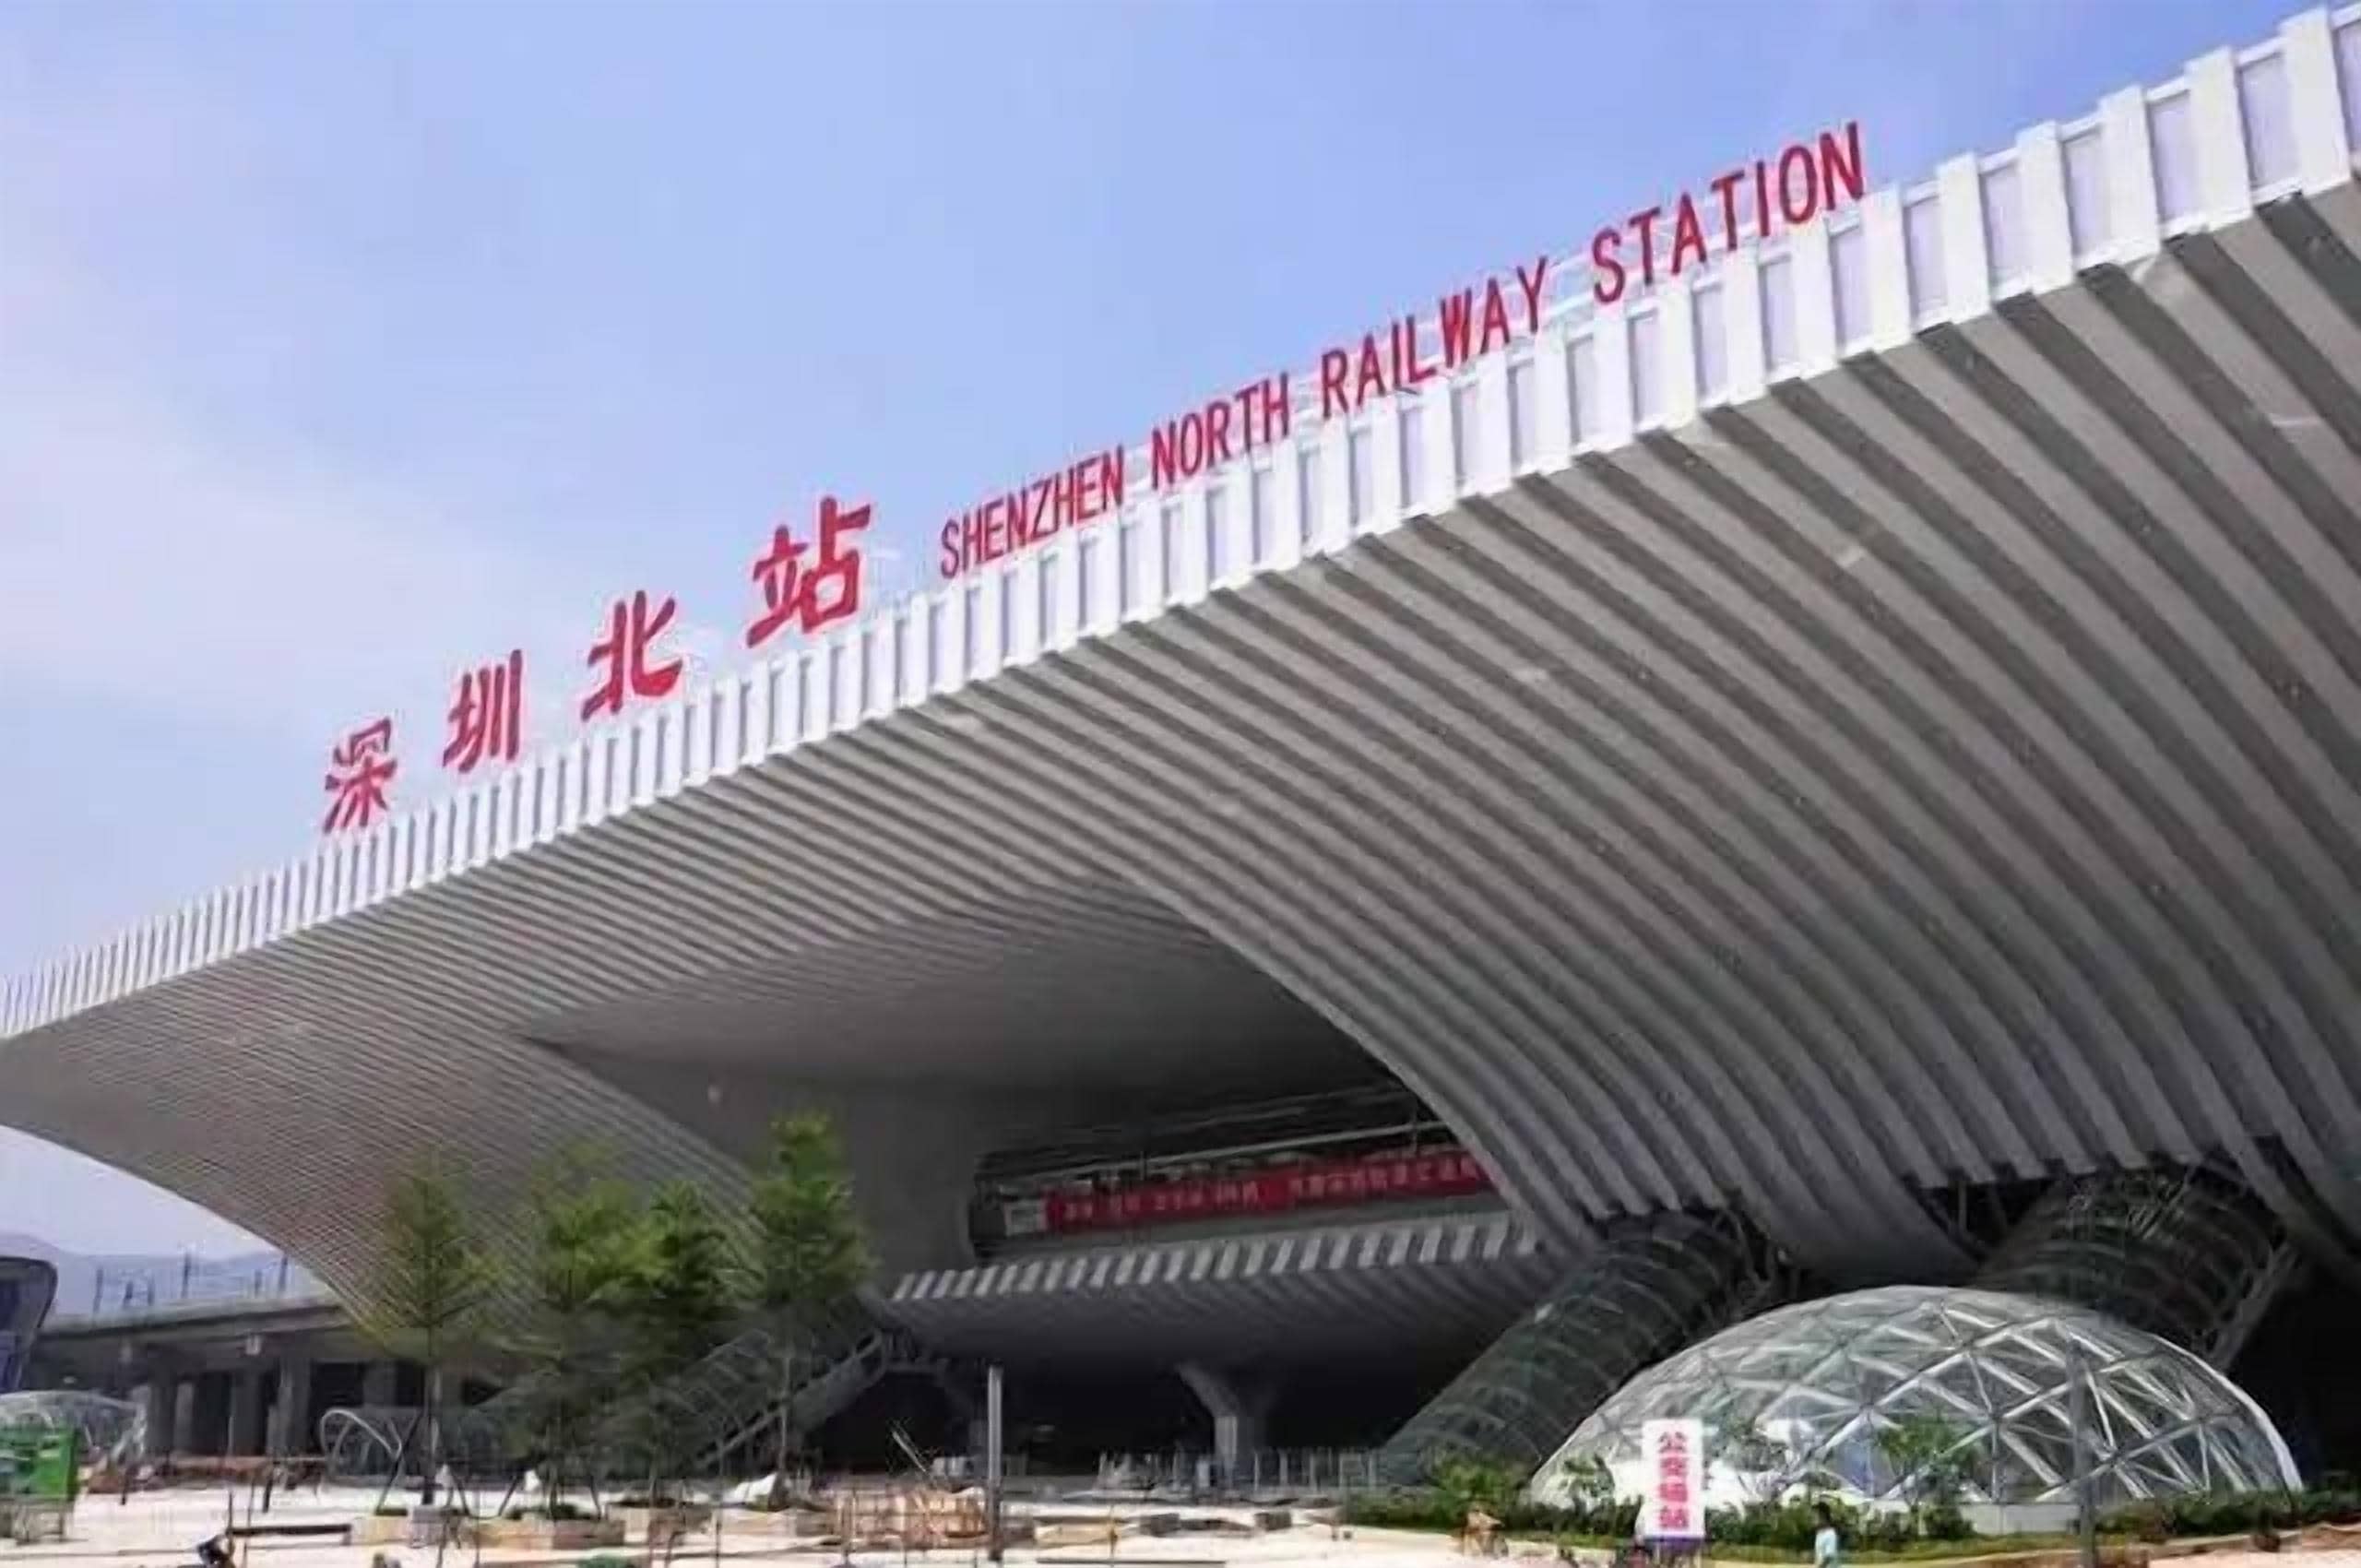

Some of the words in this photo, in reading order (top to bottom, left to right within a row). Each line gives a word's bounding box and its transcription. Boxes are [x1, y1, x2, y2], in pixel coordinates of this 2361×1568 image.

[940, 446, 1123, 578] SHENZHEN
[1151, 372, 1290, 490] NORTH
[1322, 256, 1548, 420] RAILWAY
[1592, 121, 1864, 304] STATION
[324, 496, 871, 834] 深圳北站
